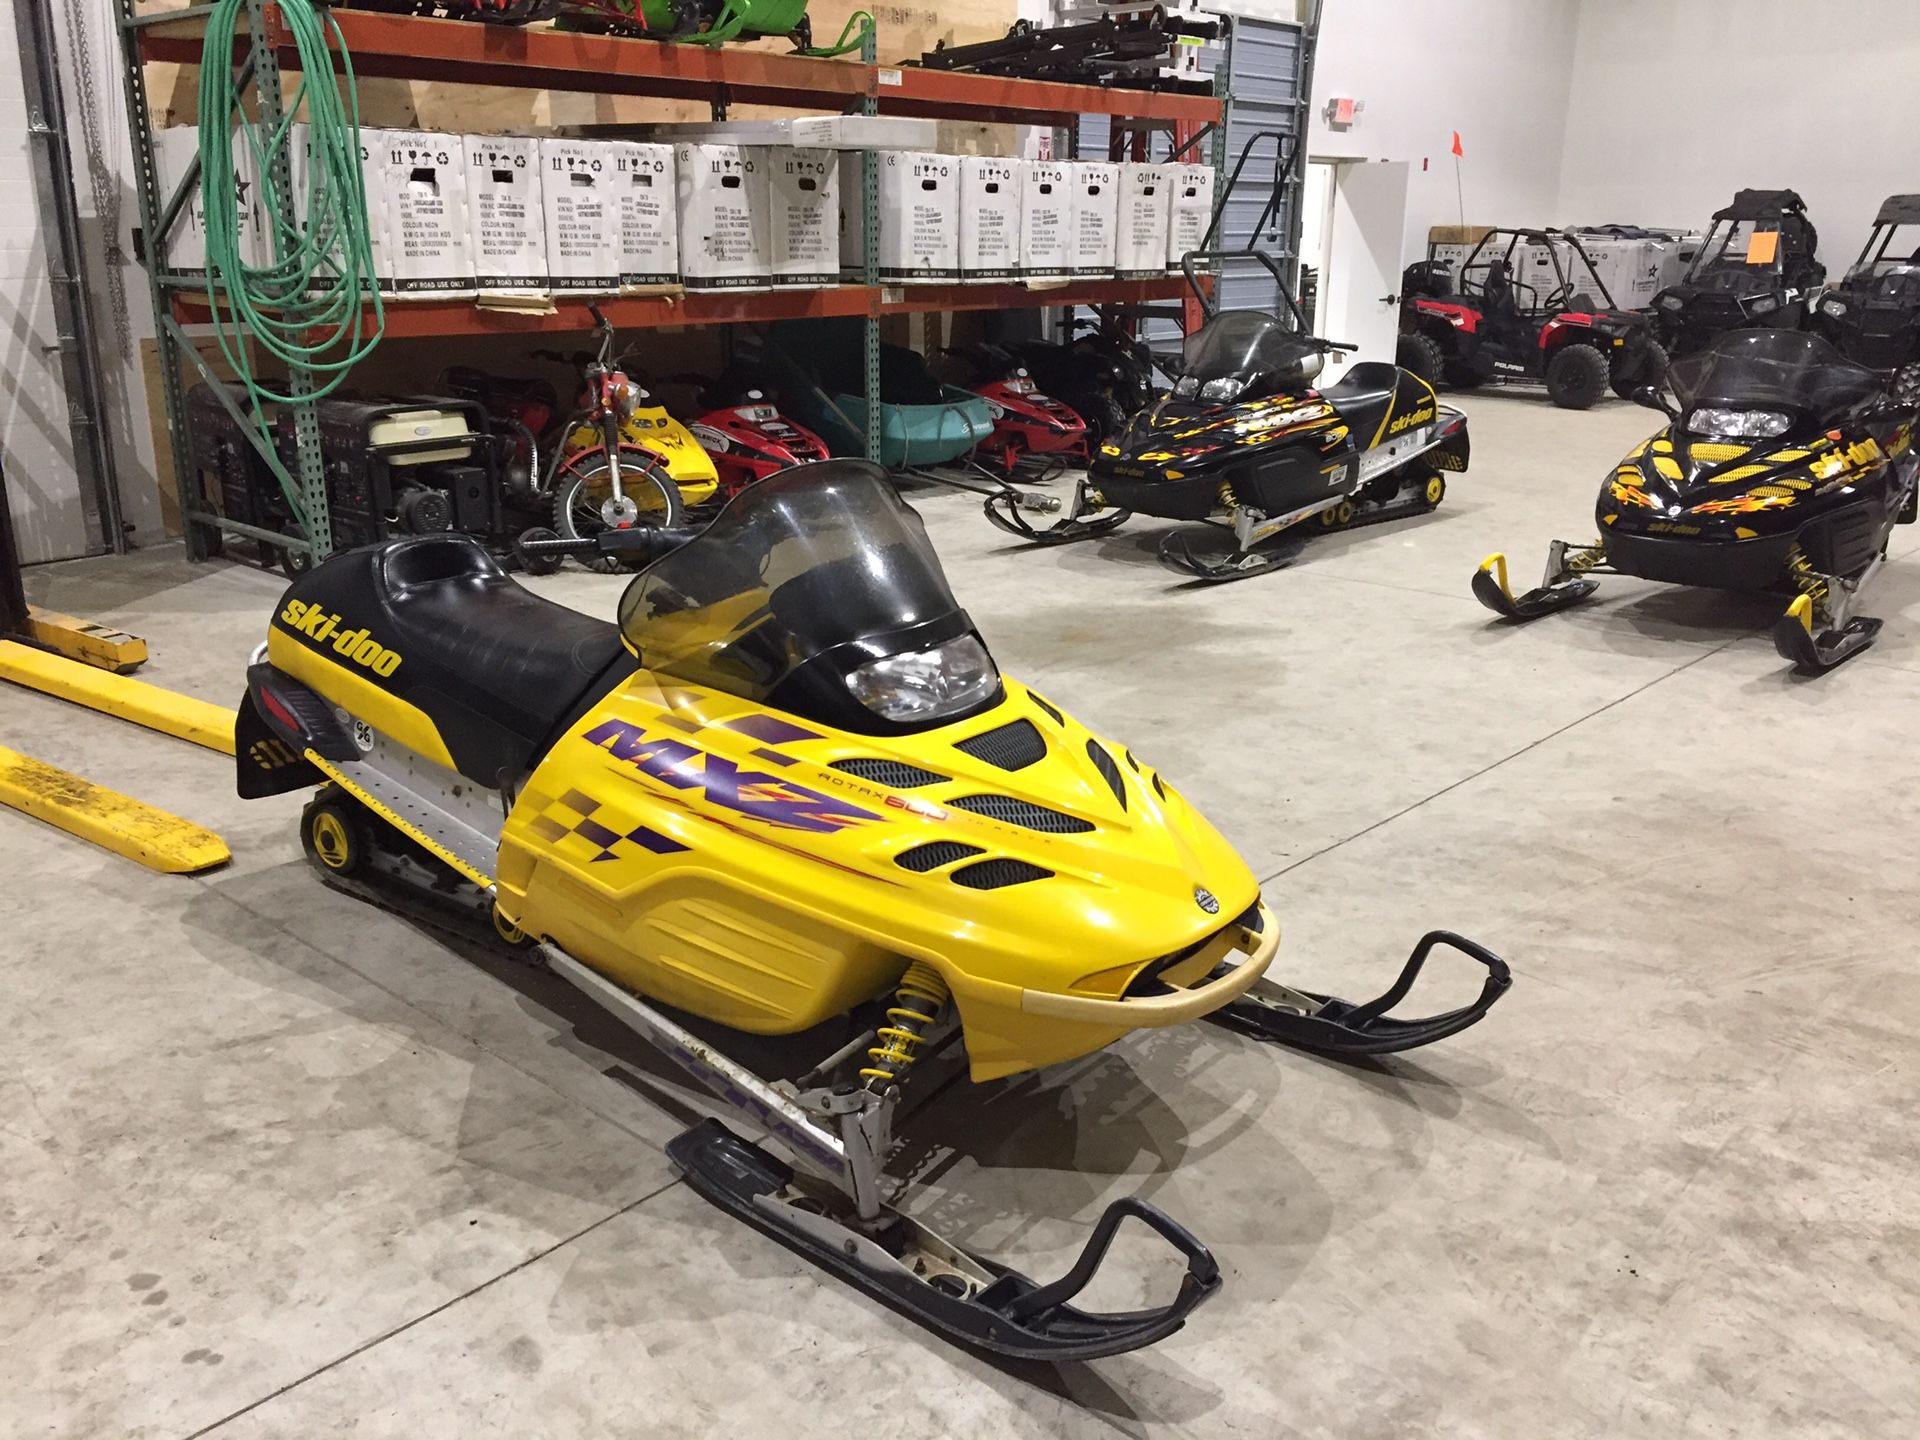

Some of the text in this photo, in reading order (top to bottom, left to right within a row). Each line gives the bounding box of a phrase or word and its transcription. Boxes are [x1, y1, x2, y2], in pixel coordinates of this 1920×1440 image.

[450, 280, 465, 288] ONLY
[496, 279, 513, 287] ROAD
[1389, 407, 1434, 434] ski-doo
[280, 598, 403, 678] ski-doo
[816, 772, 885, 800] ROTAX
